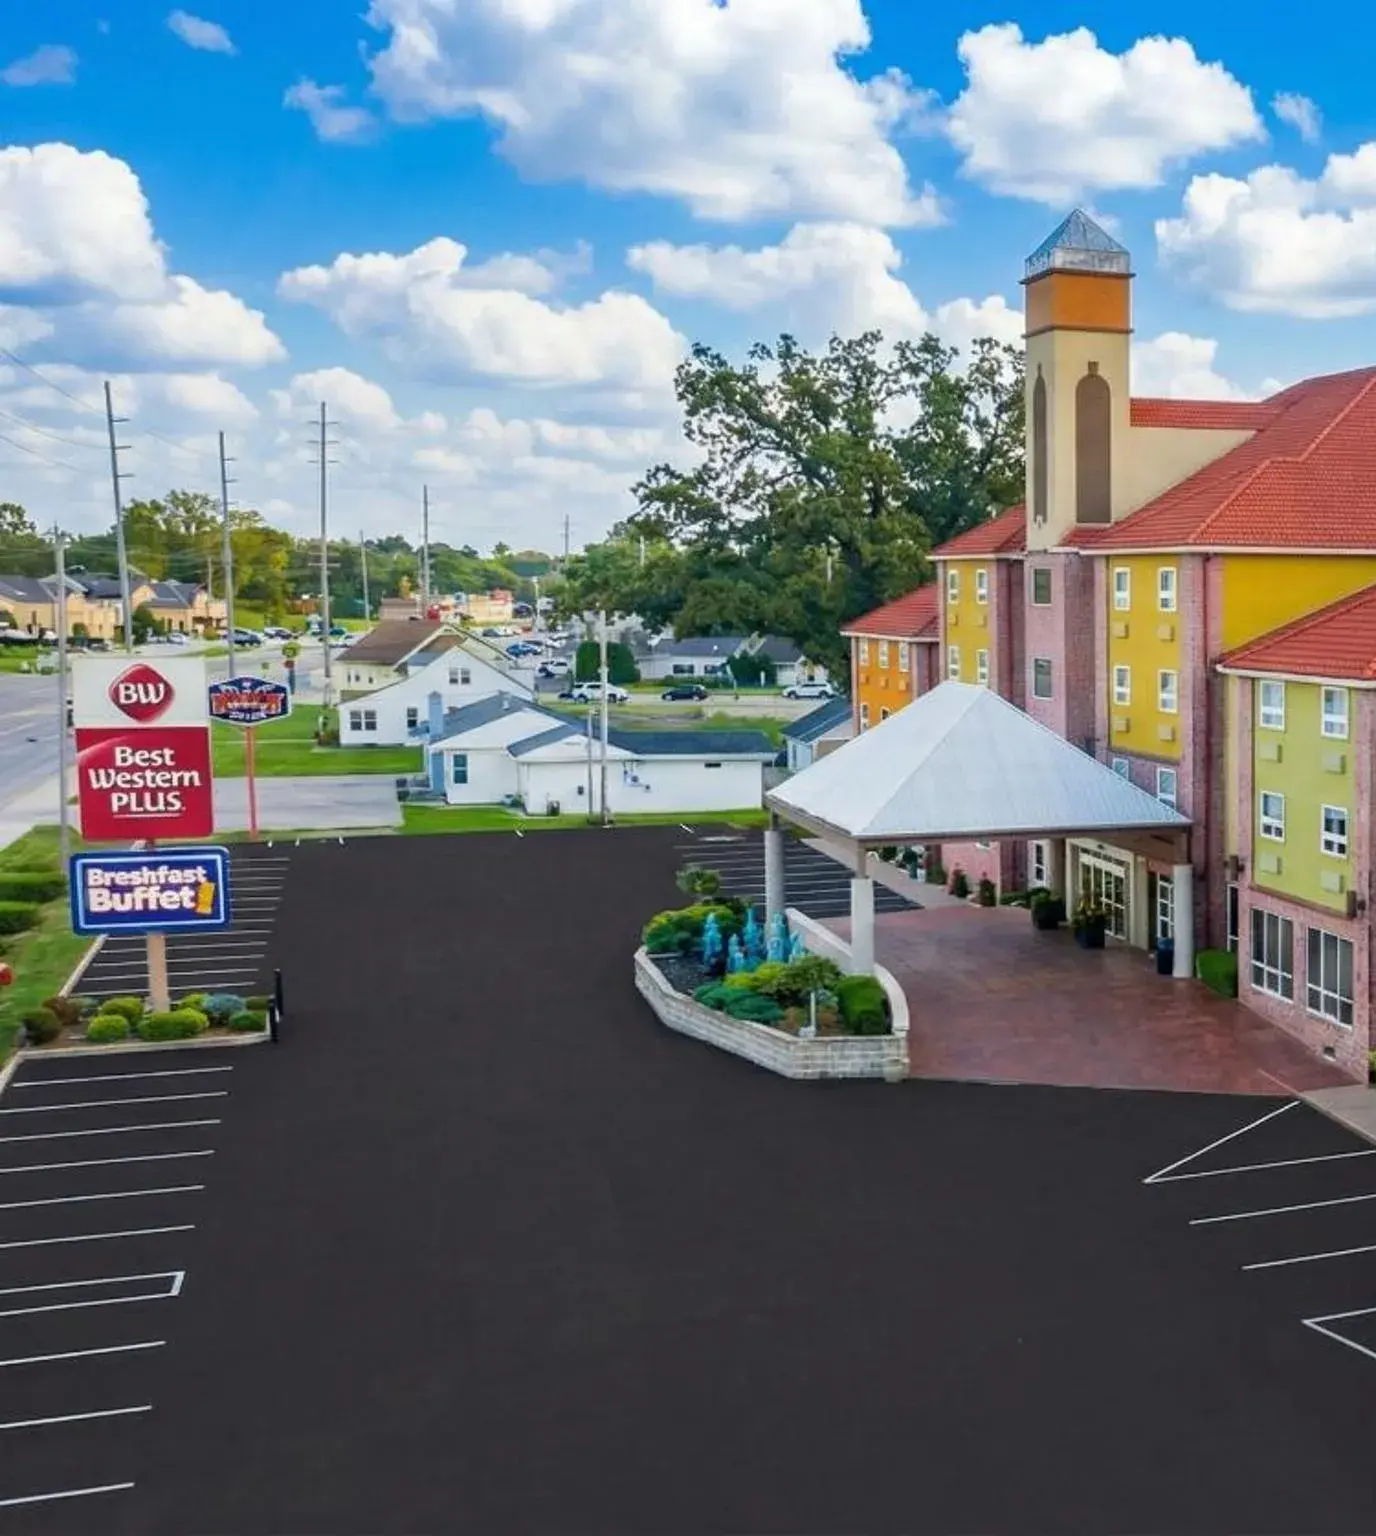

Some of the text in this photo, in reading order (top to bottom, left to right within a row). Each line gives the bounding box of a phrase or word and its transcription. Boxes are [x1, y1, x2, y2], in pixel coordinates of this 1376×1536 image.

[117, 682, 165, 705] BW
[114, 746, 176, 767] Best
[88, 768, 202, 790] Western
[88, 885, 196, 913] Buffet
